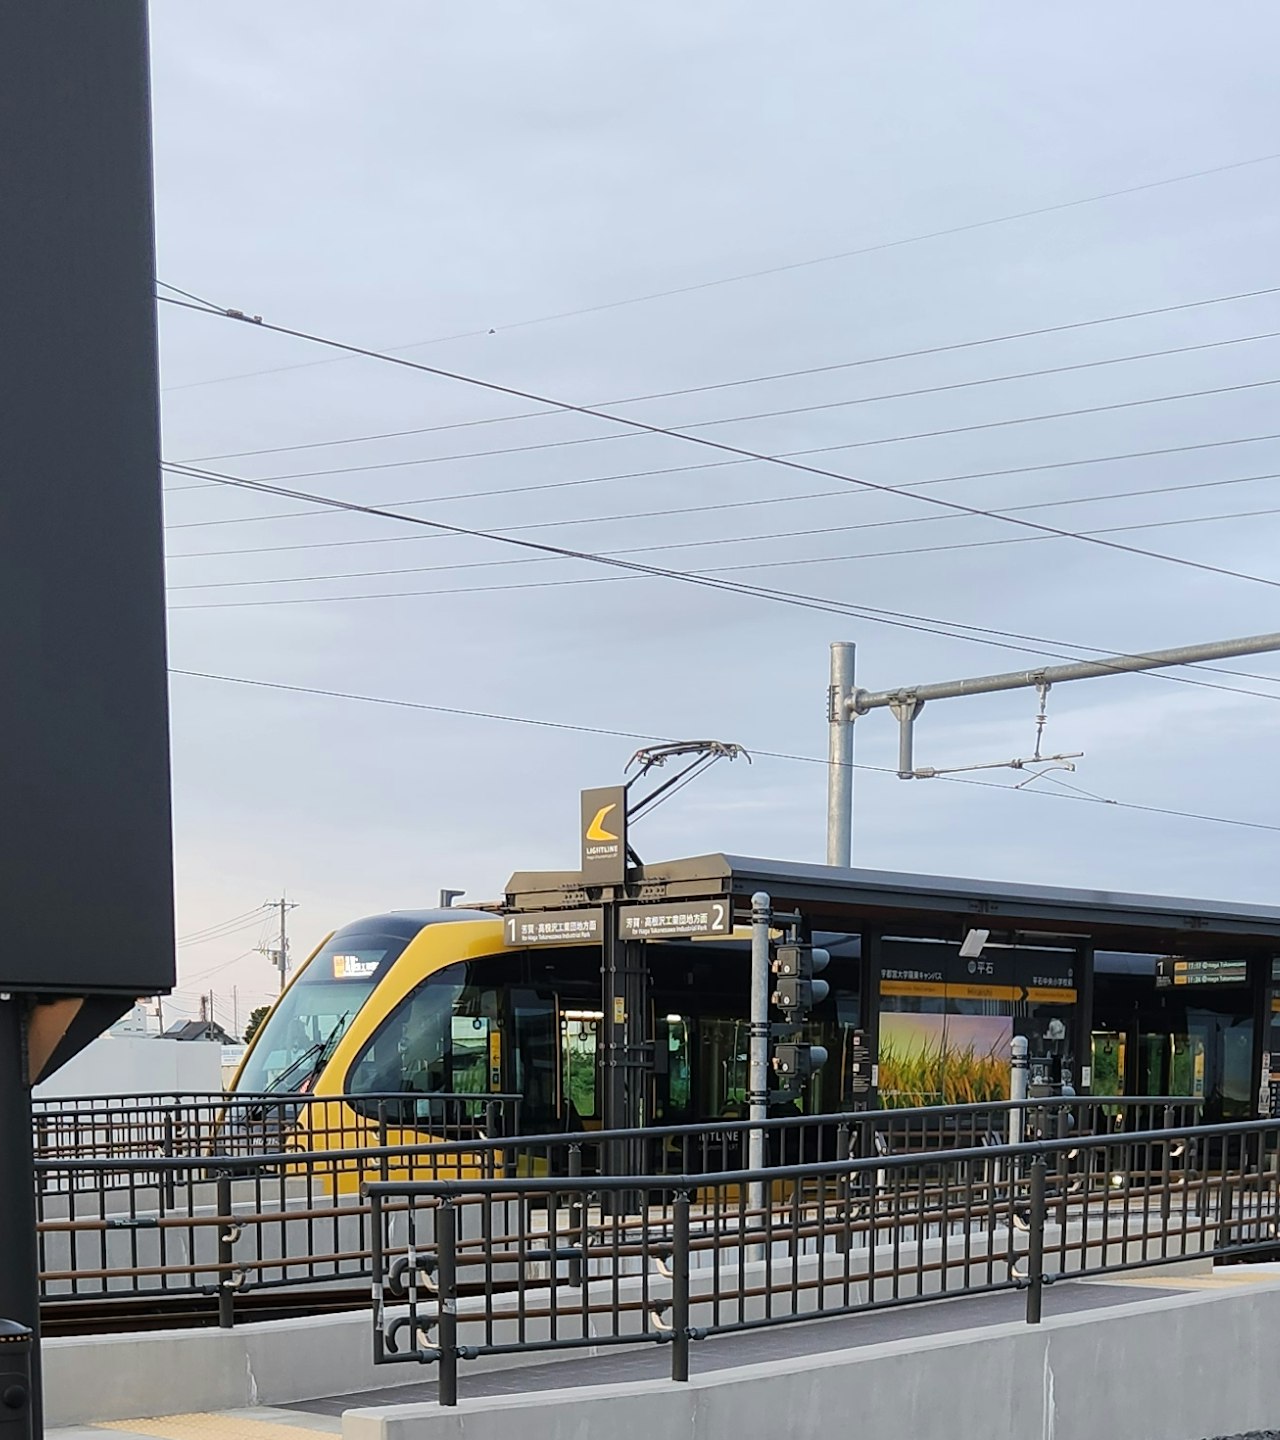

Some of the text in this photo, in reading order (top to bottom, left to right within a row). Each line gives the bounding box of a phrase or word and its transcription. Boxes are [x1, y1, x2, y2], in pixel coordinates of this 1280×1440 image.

[711, 904, 724, 930] 2
[507, 918, 516, 942] 1
[977, 961, 994, 975] 平石
[1157, 962, 1164, 975] 1
